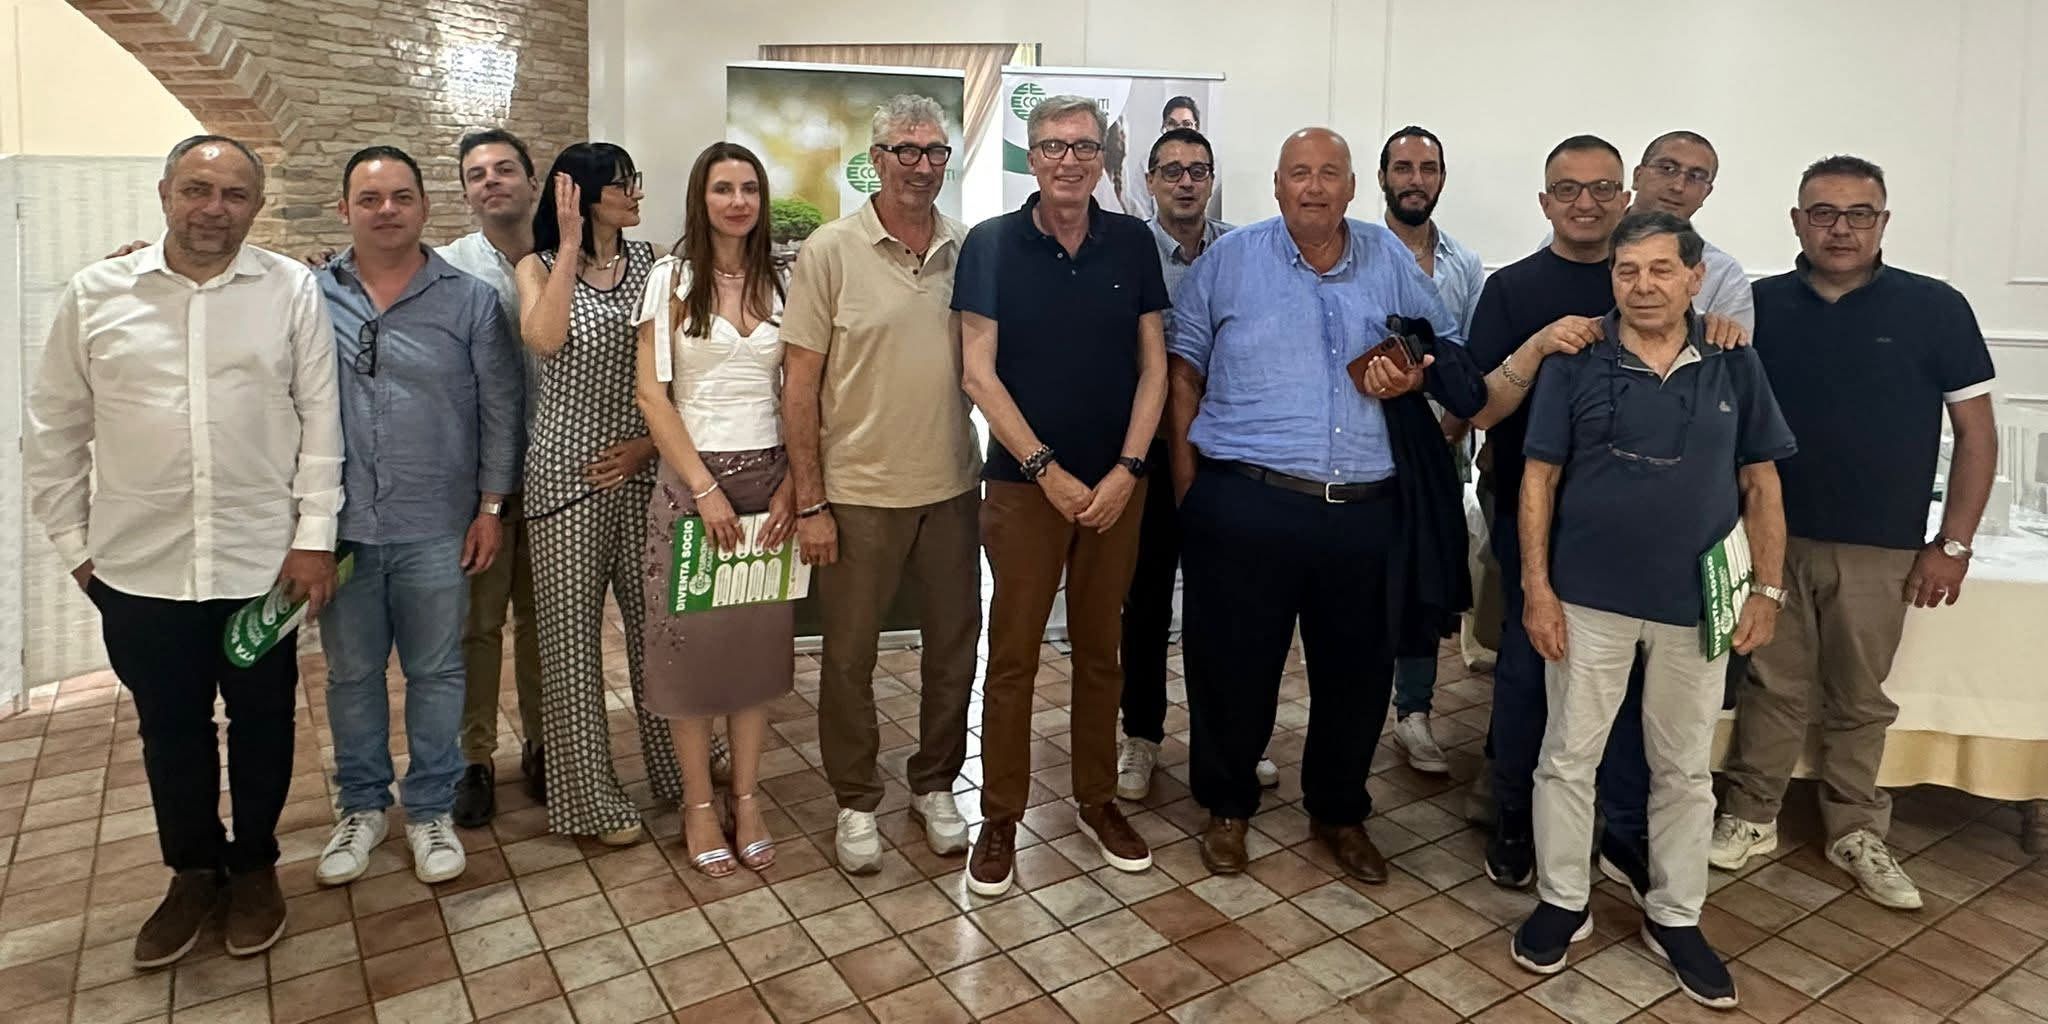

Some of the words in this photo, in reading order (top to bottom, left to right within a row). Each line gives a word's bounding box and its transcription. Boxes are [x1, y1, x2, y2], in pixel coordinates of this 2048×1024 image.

[681, 519, 694, 559] SOCIO
[675, 560, 691, 612] DIVENTA
[1706, 555, 1718, 598] SOCIO
